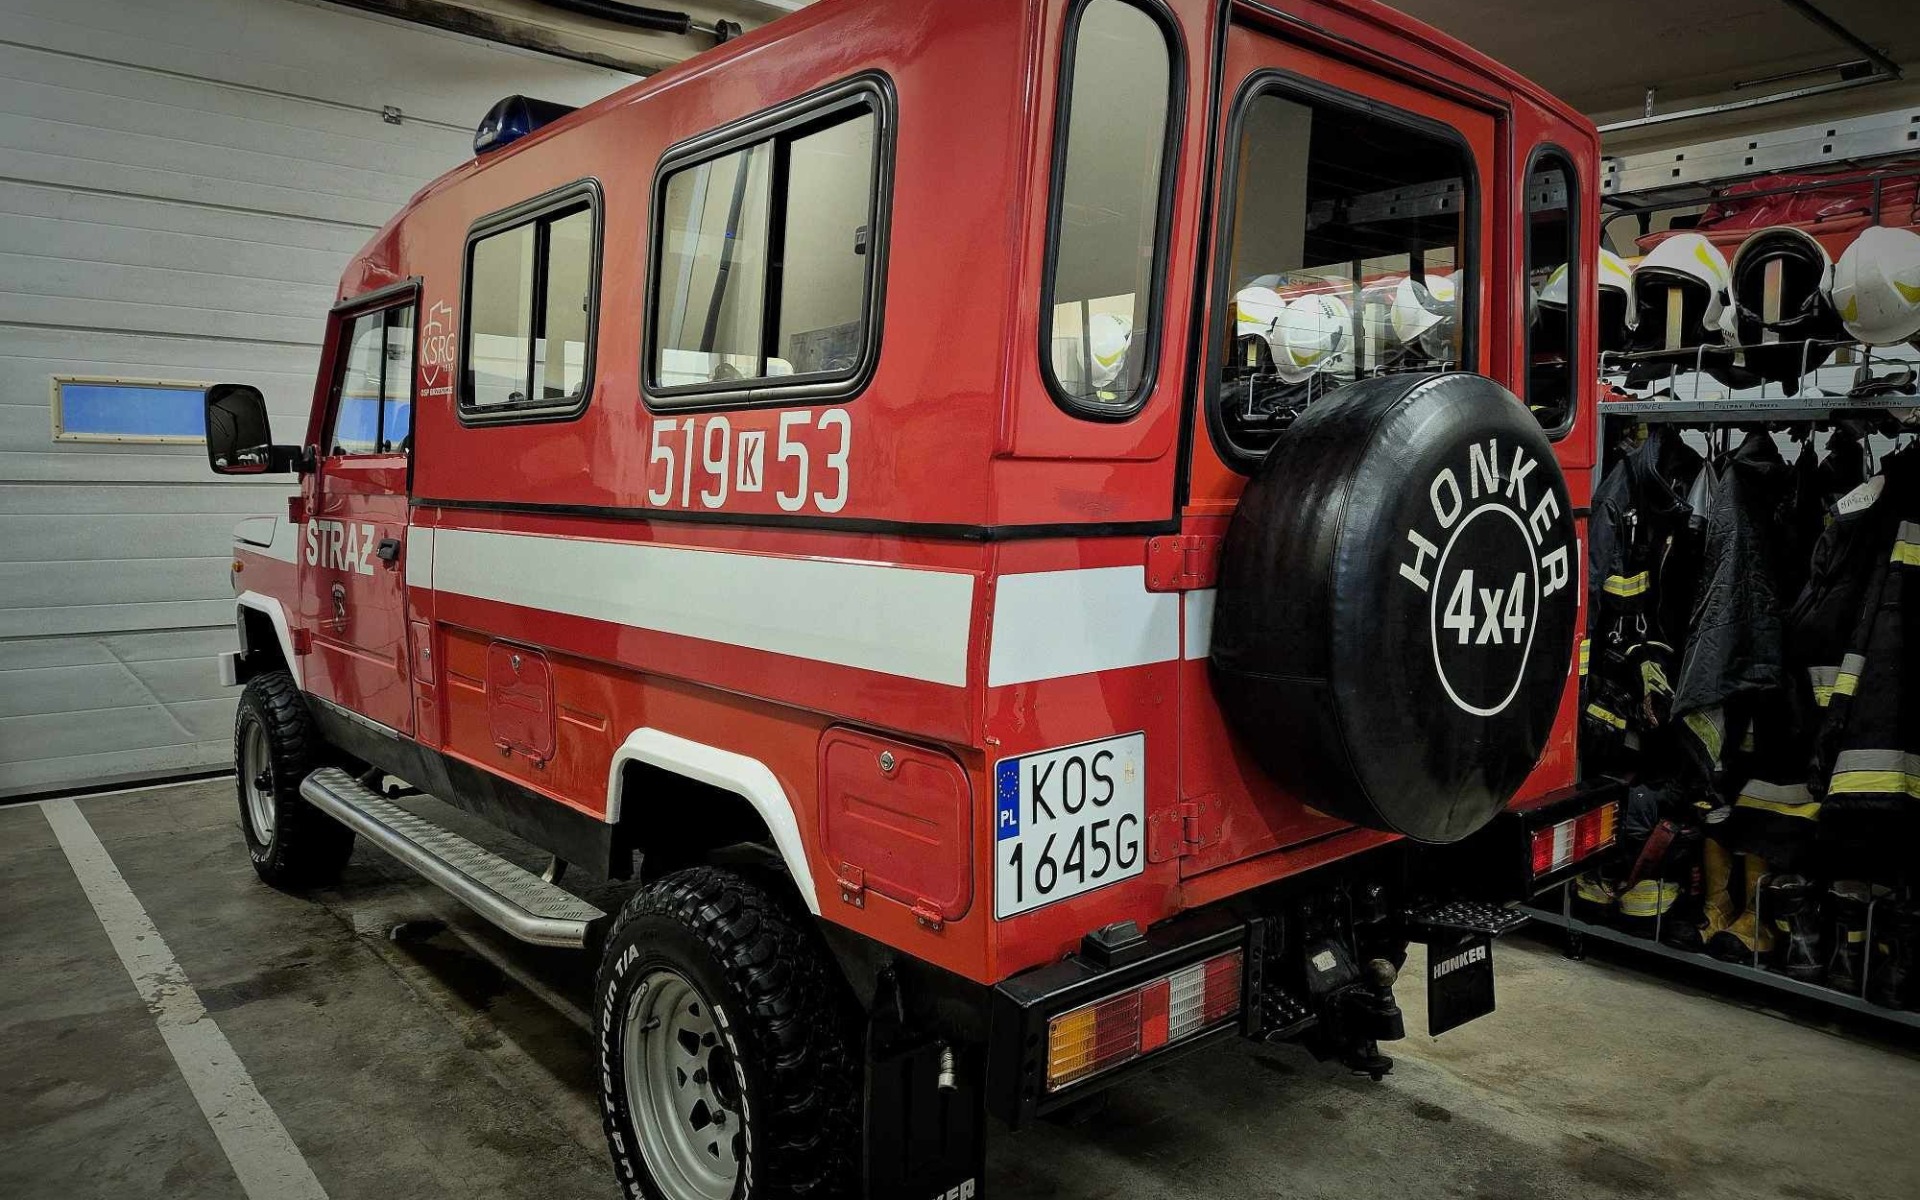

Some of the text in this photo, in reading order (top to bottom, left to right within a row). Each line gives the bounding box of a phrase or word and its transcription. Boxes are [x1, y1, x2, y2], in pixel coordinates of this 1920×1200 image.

[422, 333, 455, 365] KSRG
[648, 408, 851, 513] 519 K 53
[306, 519, 375, 576] STRAŻ
[1399, 438, 1569, 598] HONKER
[1443, 569, 1527, 644] 4x4
[1000, 809, 1017, 828] PL
[1032, 750, 1115, 825] KOS
[1009, 813, 1138, 903] 1645G
[1433, 945, 1486, 979] HONKER
